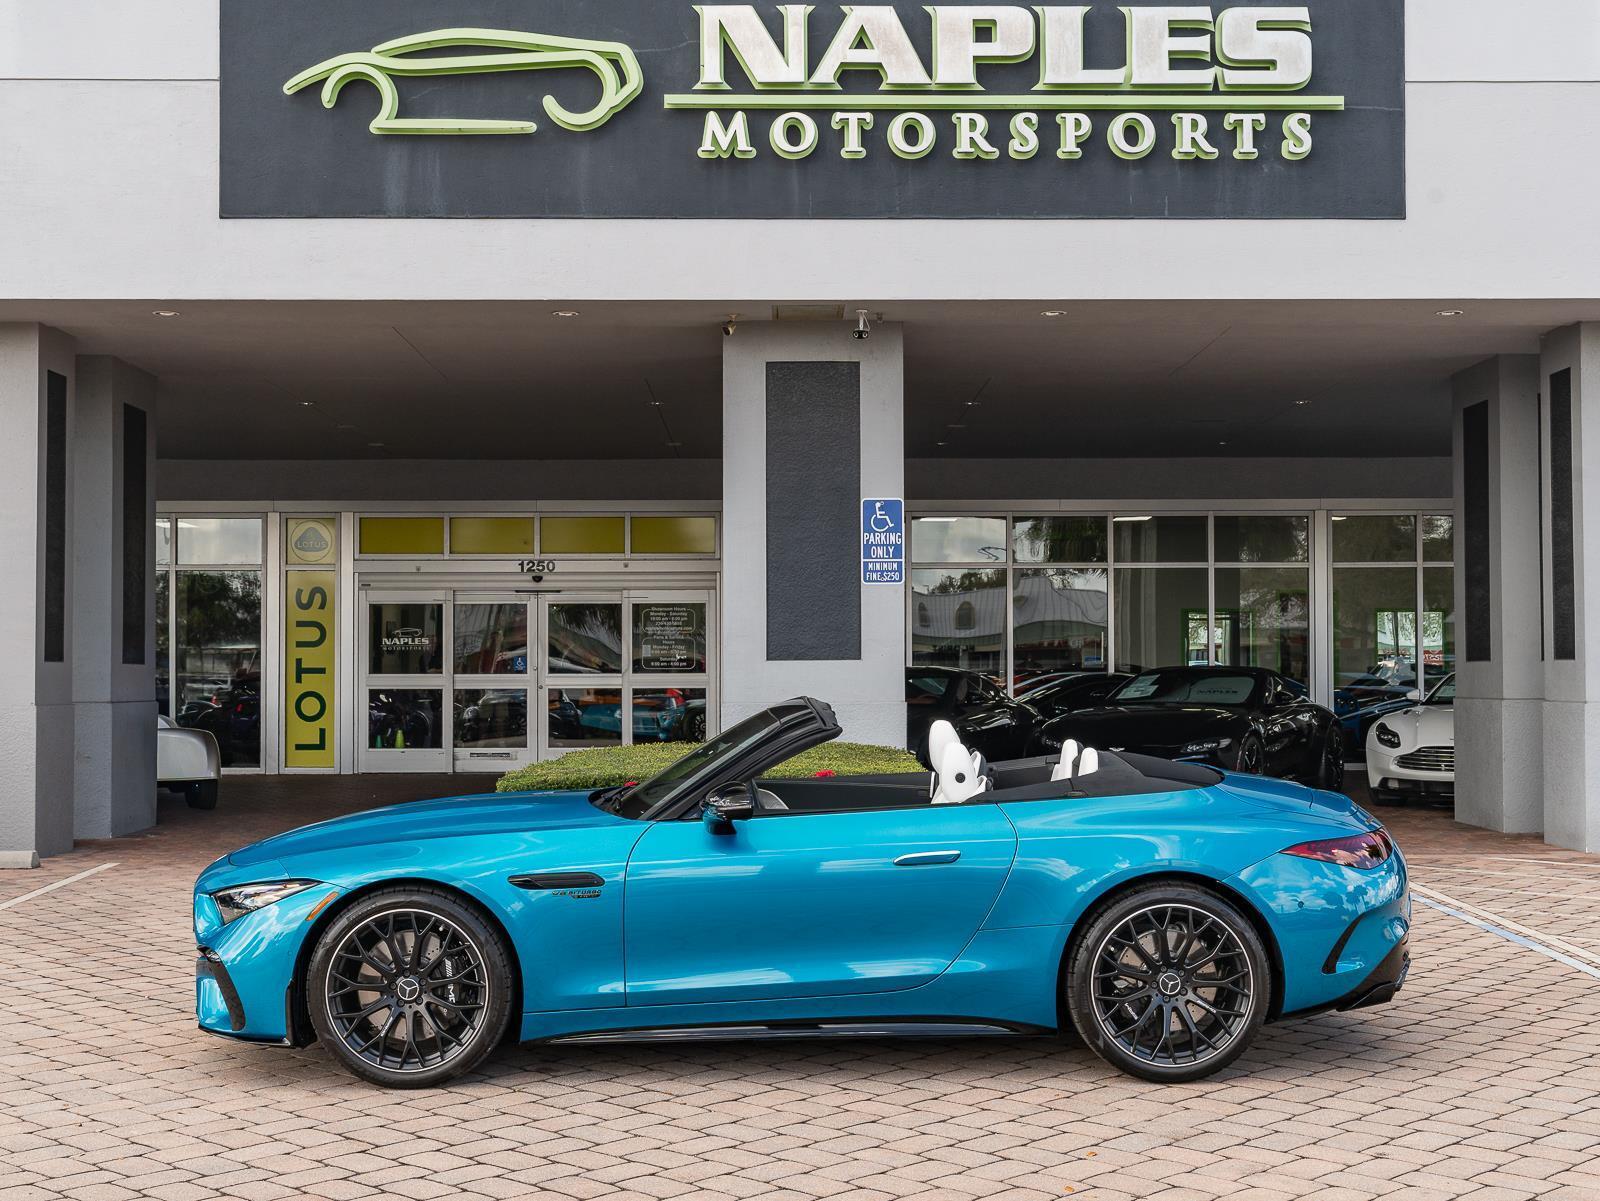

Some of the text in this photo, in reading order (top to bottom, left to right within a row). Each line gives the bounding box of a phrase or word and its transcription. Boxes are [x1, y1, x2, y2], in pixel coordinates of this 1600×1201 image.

[692, 5, 1313, 91] NAPLES
[698, 111, 1313, 160] MOTORSPORTS
[864, 532, 902, 545] PARKING
[871, 546, 895, 558] ONLY
[518, 560, 556, 573] 1250
[868, 562, 898, 571] MINIMUM
[866, 572, 900, 581] FINE $250
[382, 637, 430, 645] NAPLES
[294, 585, 327, 751] LOTUS
